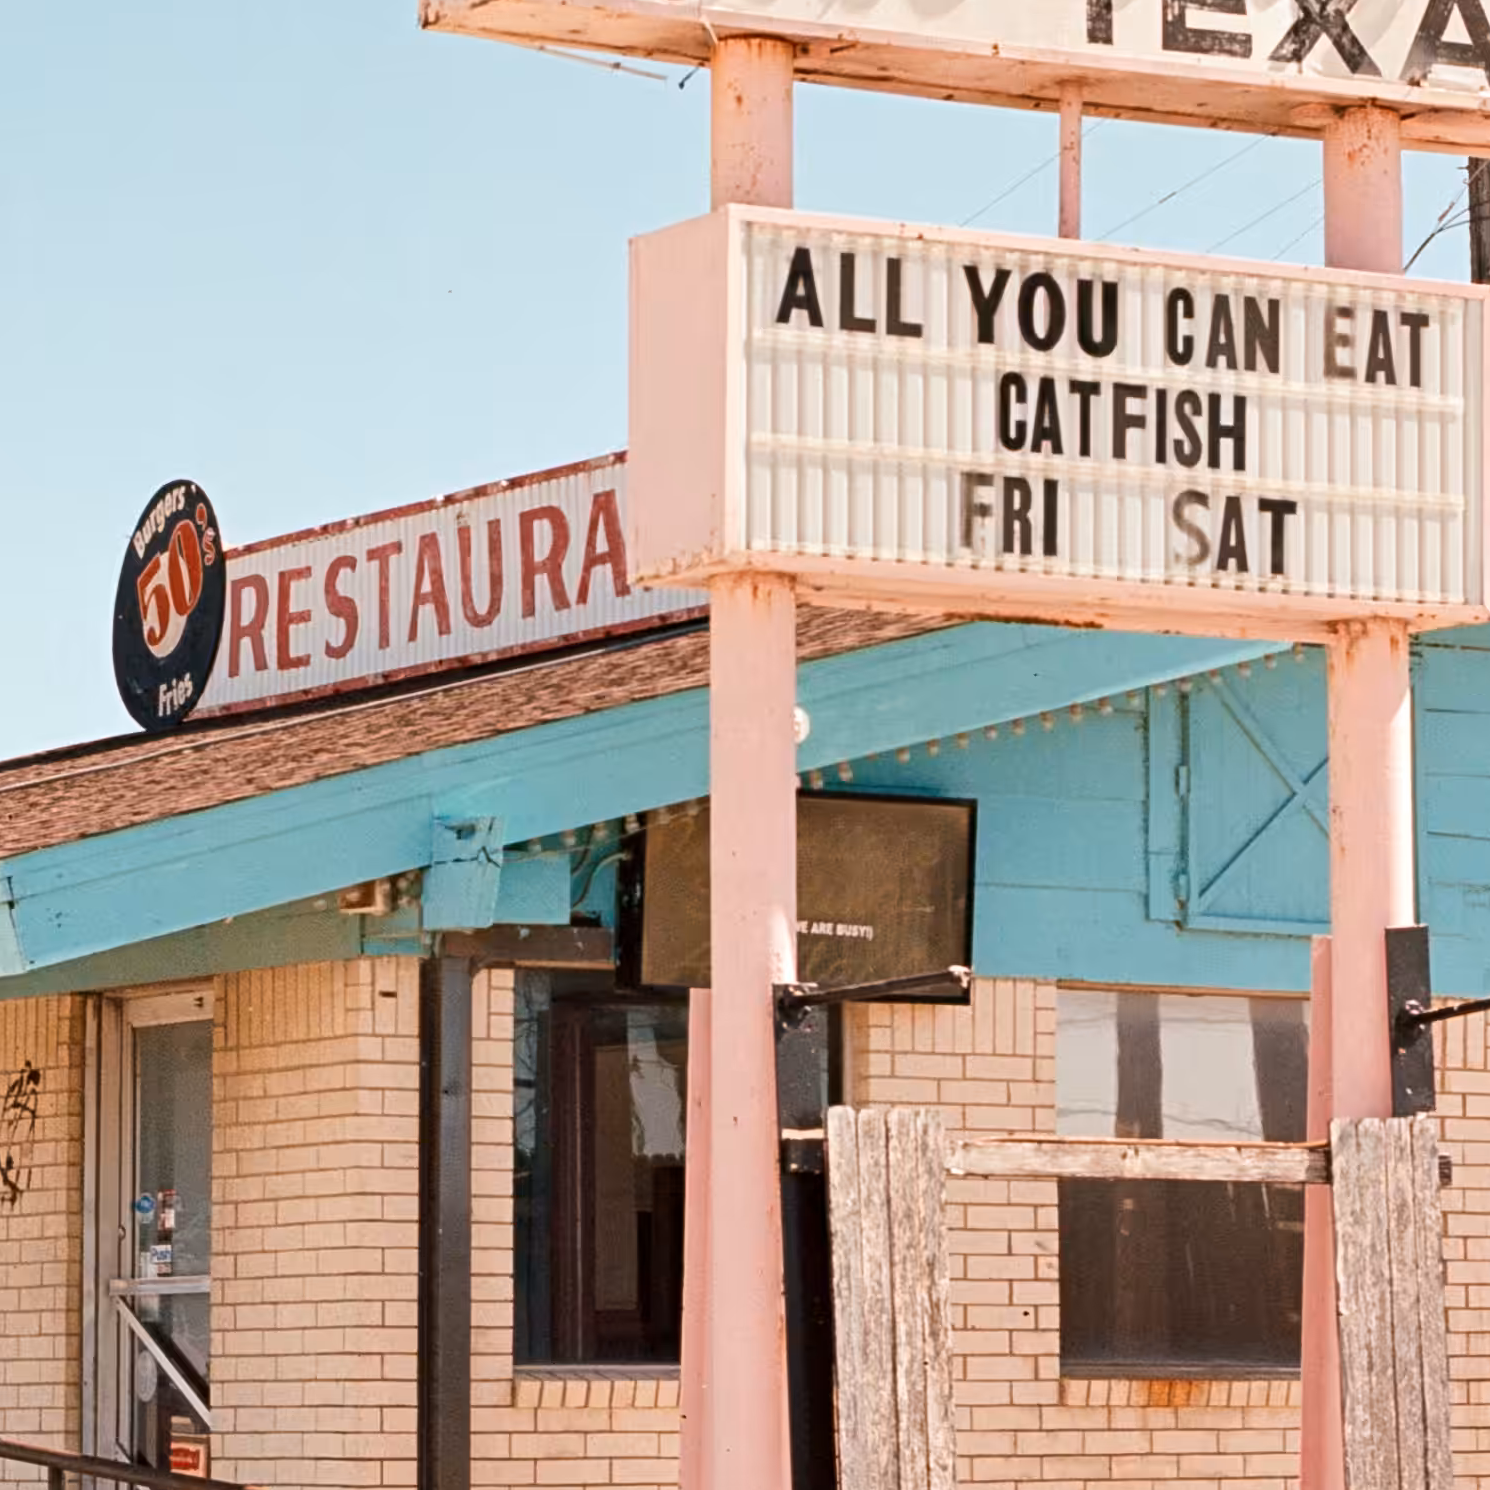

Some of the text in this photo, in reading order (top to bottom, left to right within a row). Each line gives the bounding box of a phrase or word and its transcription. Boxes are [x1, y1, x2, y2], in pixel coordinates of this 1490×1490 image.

[775, 247, 1430, 388] ALL YOU CAN EAT
[999, 371, 1247, 472] CATFISH
[133, 485, 186, 559] Burgers
[960, 471, 1298, 576] FRI SAT
[227, 488, 632, 679] RESTAURA
[157, 672, 194, 717] Fries
[811, 922, 834, 936] ARE
